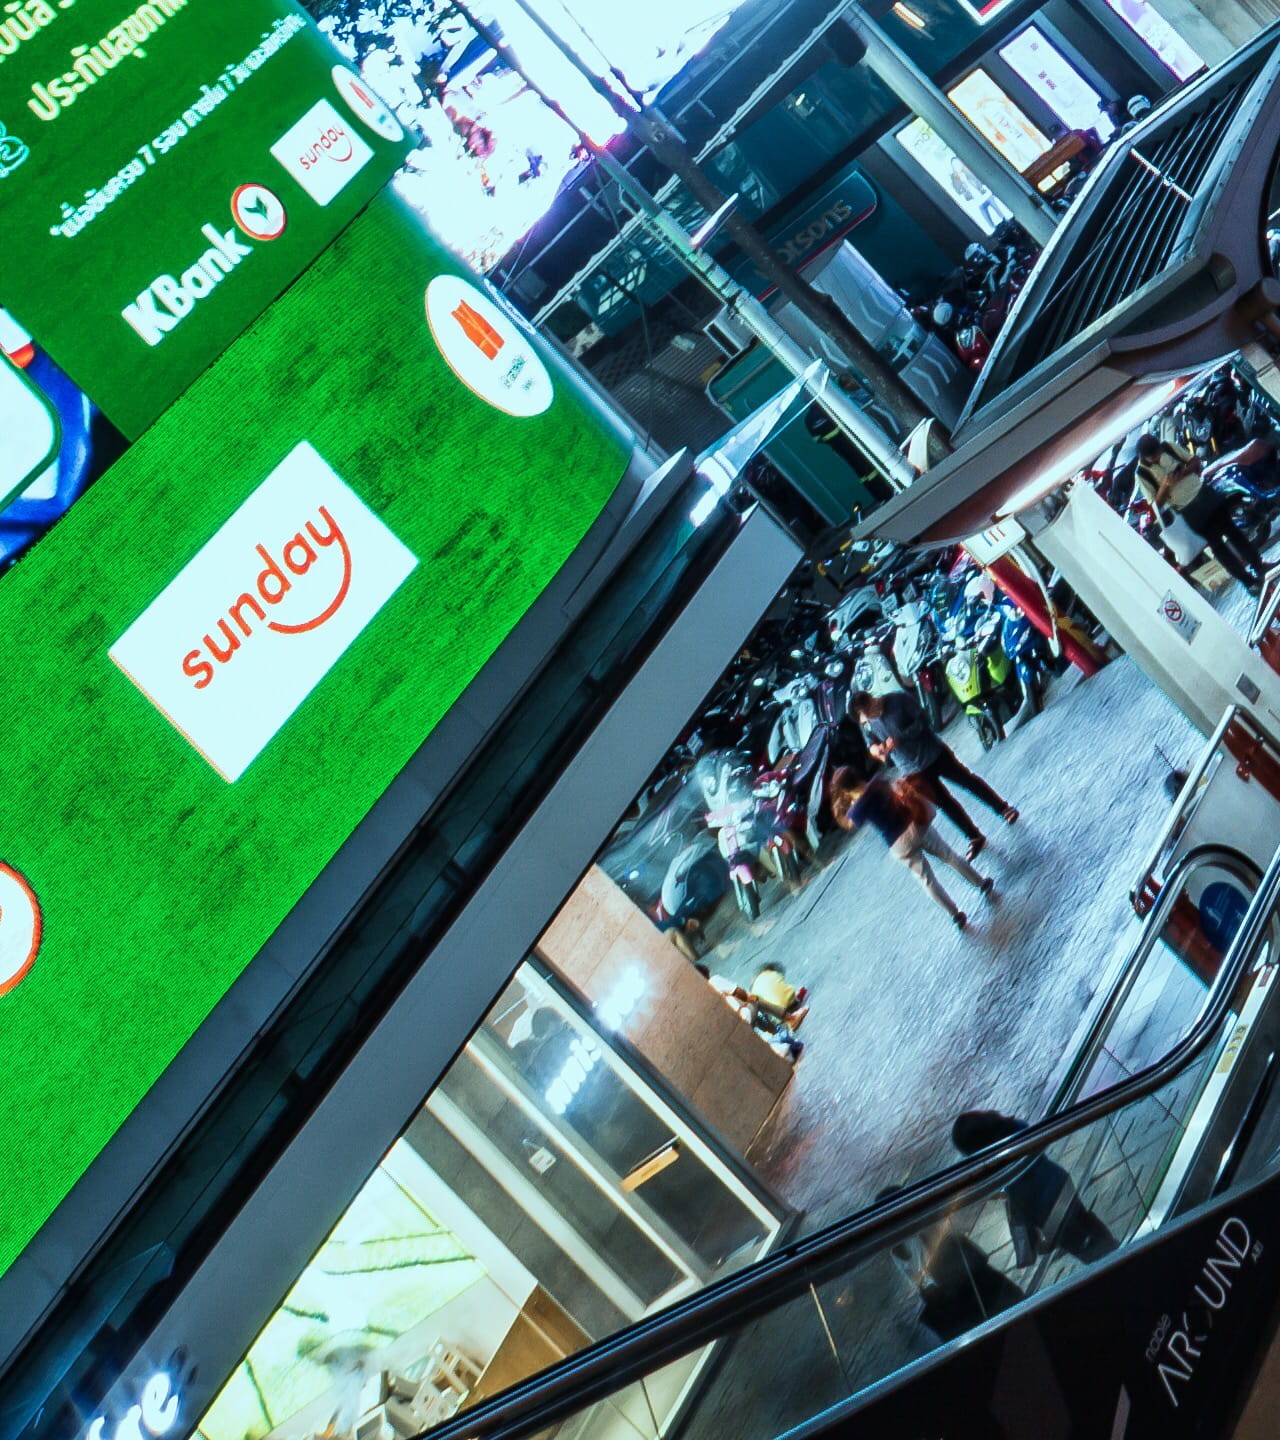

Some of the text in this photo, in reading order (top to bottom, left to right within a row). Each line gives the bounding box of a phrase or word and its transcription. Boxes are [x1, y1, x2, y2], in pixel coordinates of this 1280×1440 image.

[137, 143, 157, 165] 7
[299, 120, 353, 170] sunday
[121, 222, 253, 347] KBank
[180, 505, 353, 691] sunday
